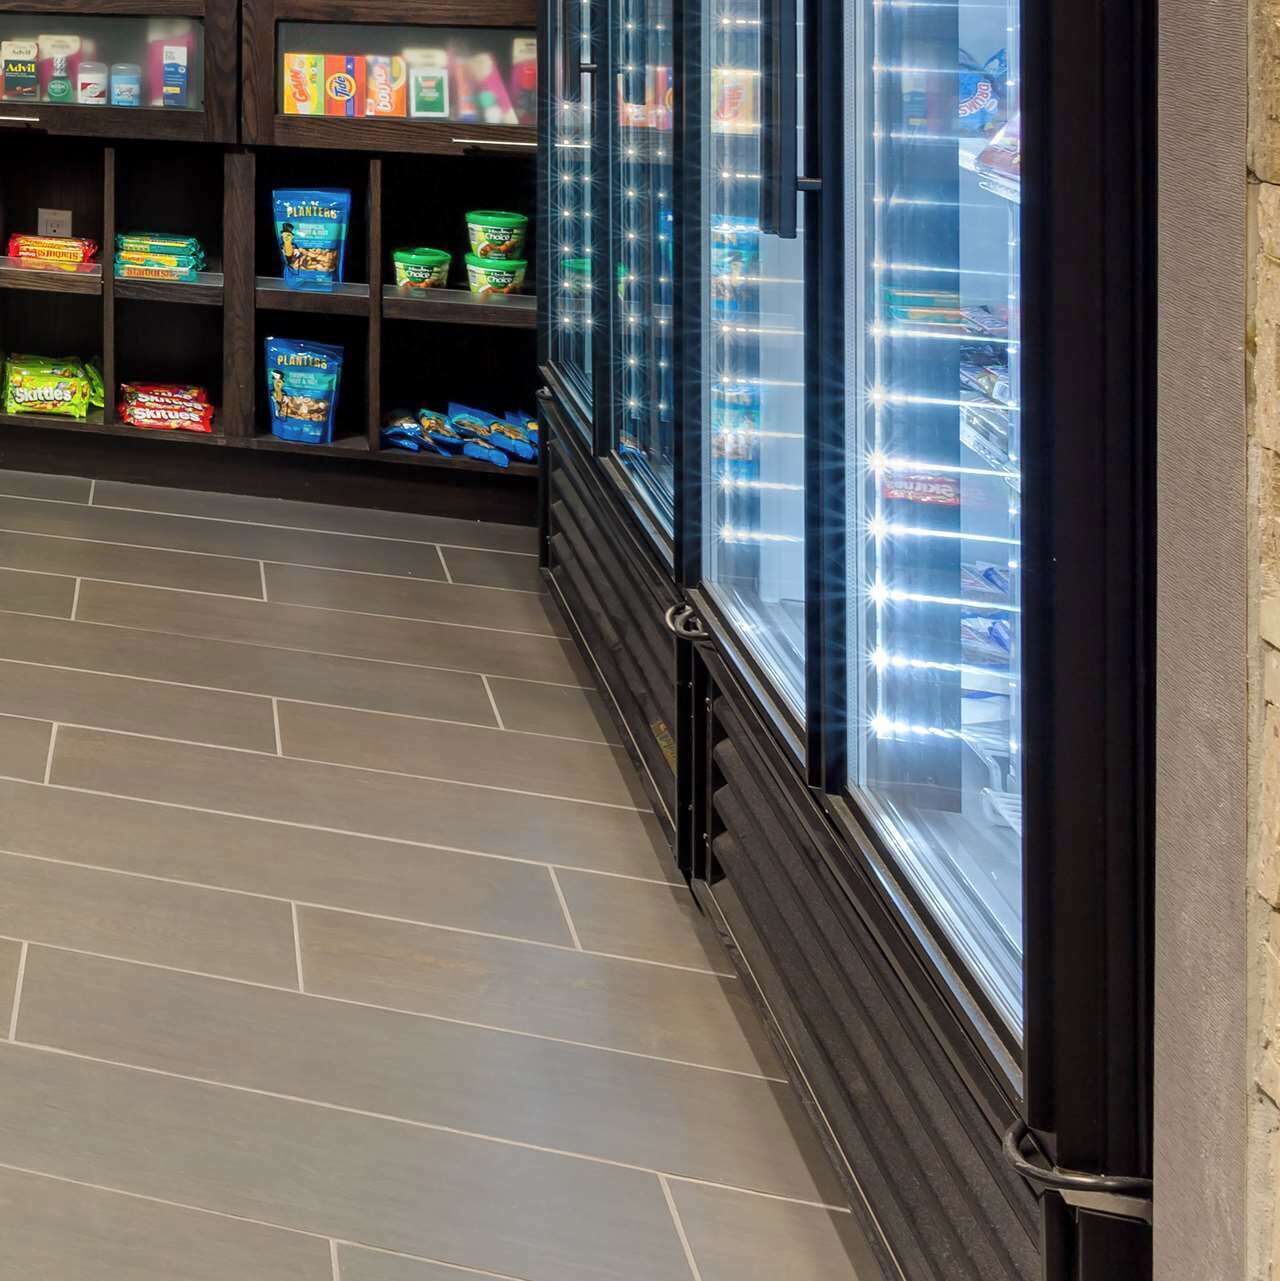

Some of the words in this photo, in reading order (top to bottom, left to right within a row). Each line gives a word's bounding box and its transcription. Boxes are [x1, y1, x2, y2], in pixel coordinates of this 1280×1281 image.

[6, 63, 35, 73] Advil
[334, 76, 350, 98] Tide
[485, 232, 510, 241] Choice
[407, 270, 430, 279] Choice
